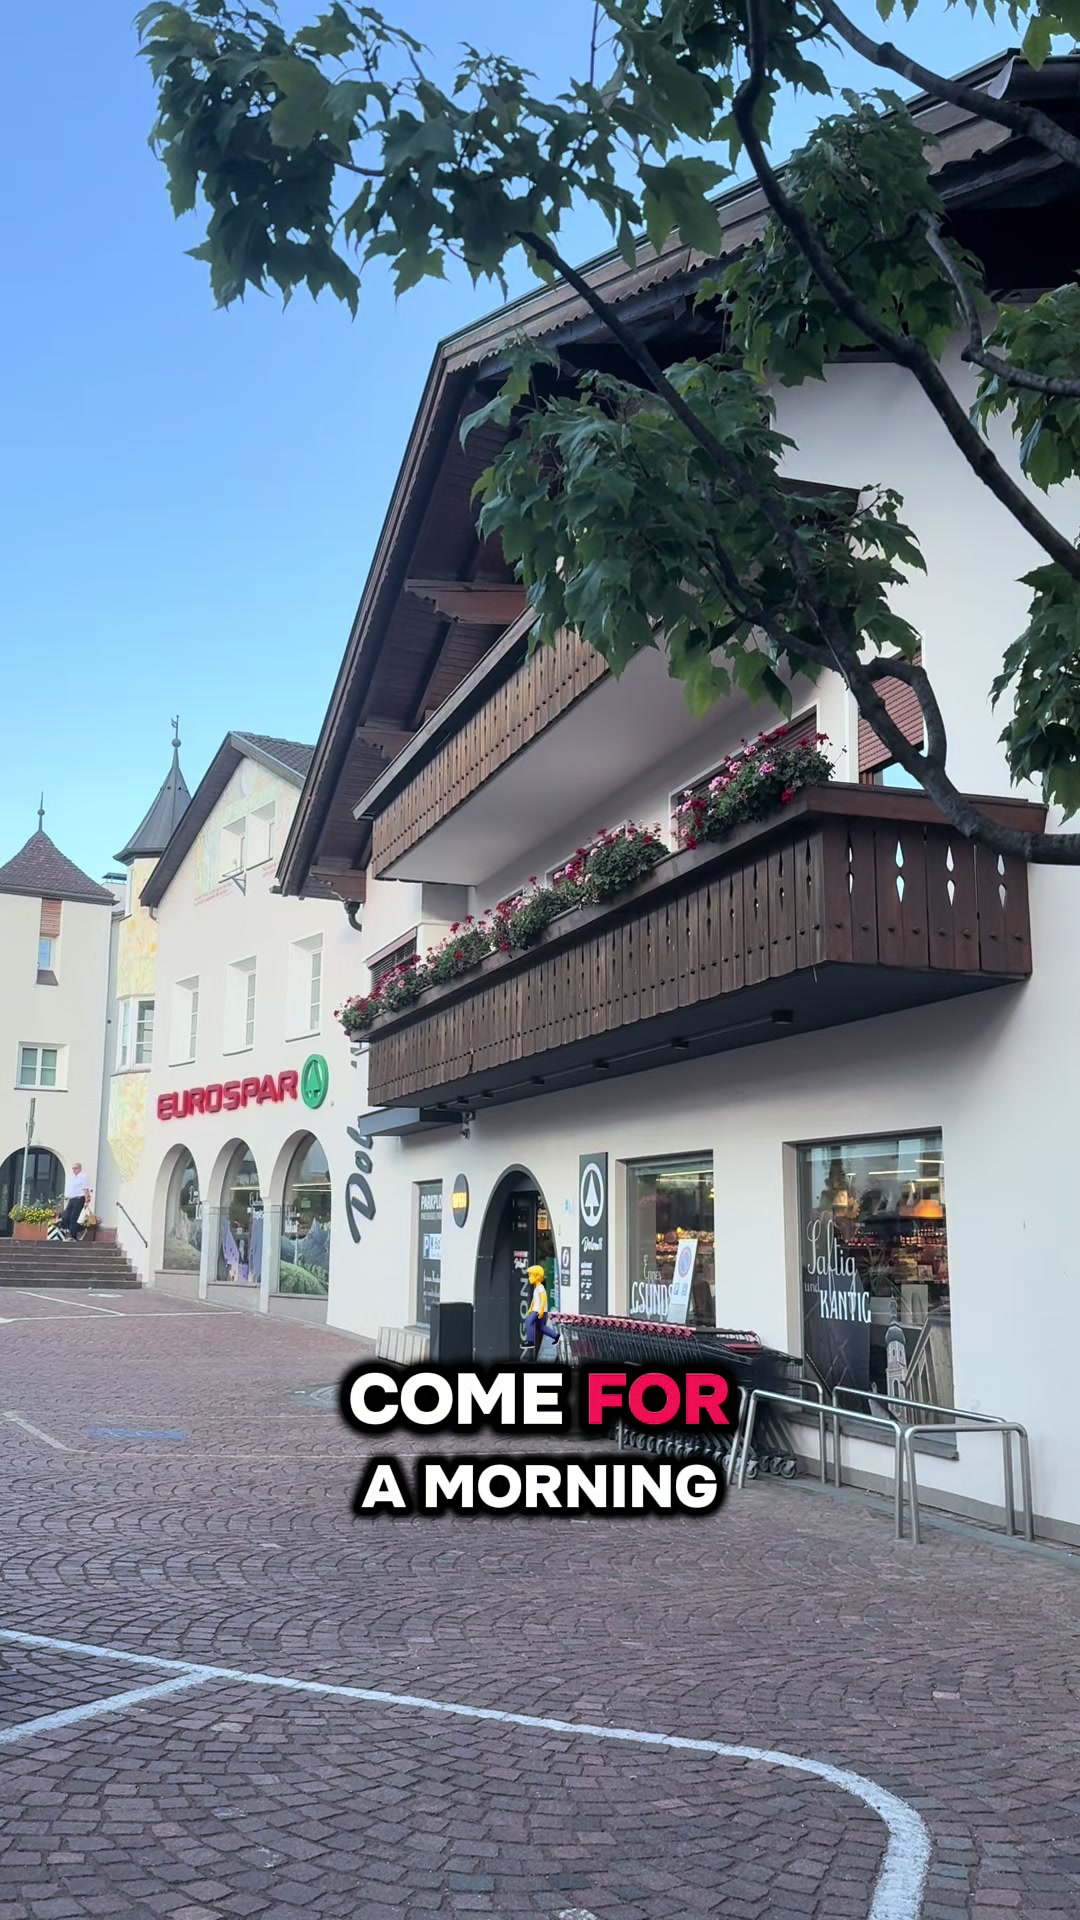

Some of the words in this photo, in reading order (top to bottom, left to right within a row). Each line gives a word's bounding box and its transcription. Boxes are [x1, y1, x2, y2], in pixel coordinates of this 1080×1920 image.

[157, 1069, 298, 1121] EUROSPAR
[804, 1276, 820, 1293] und
[820, 1289, 872, 1323] KANTIG
